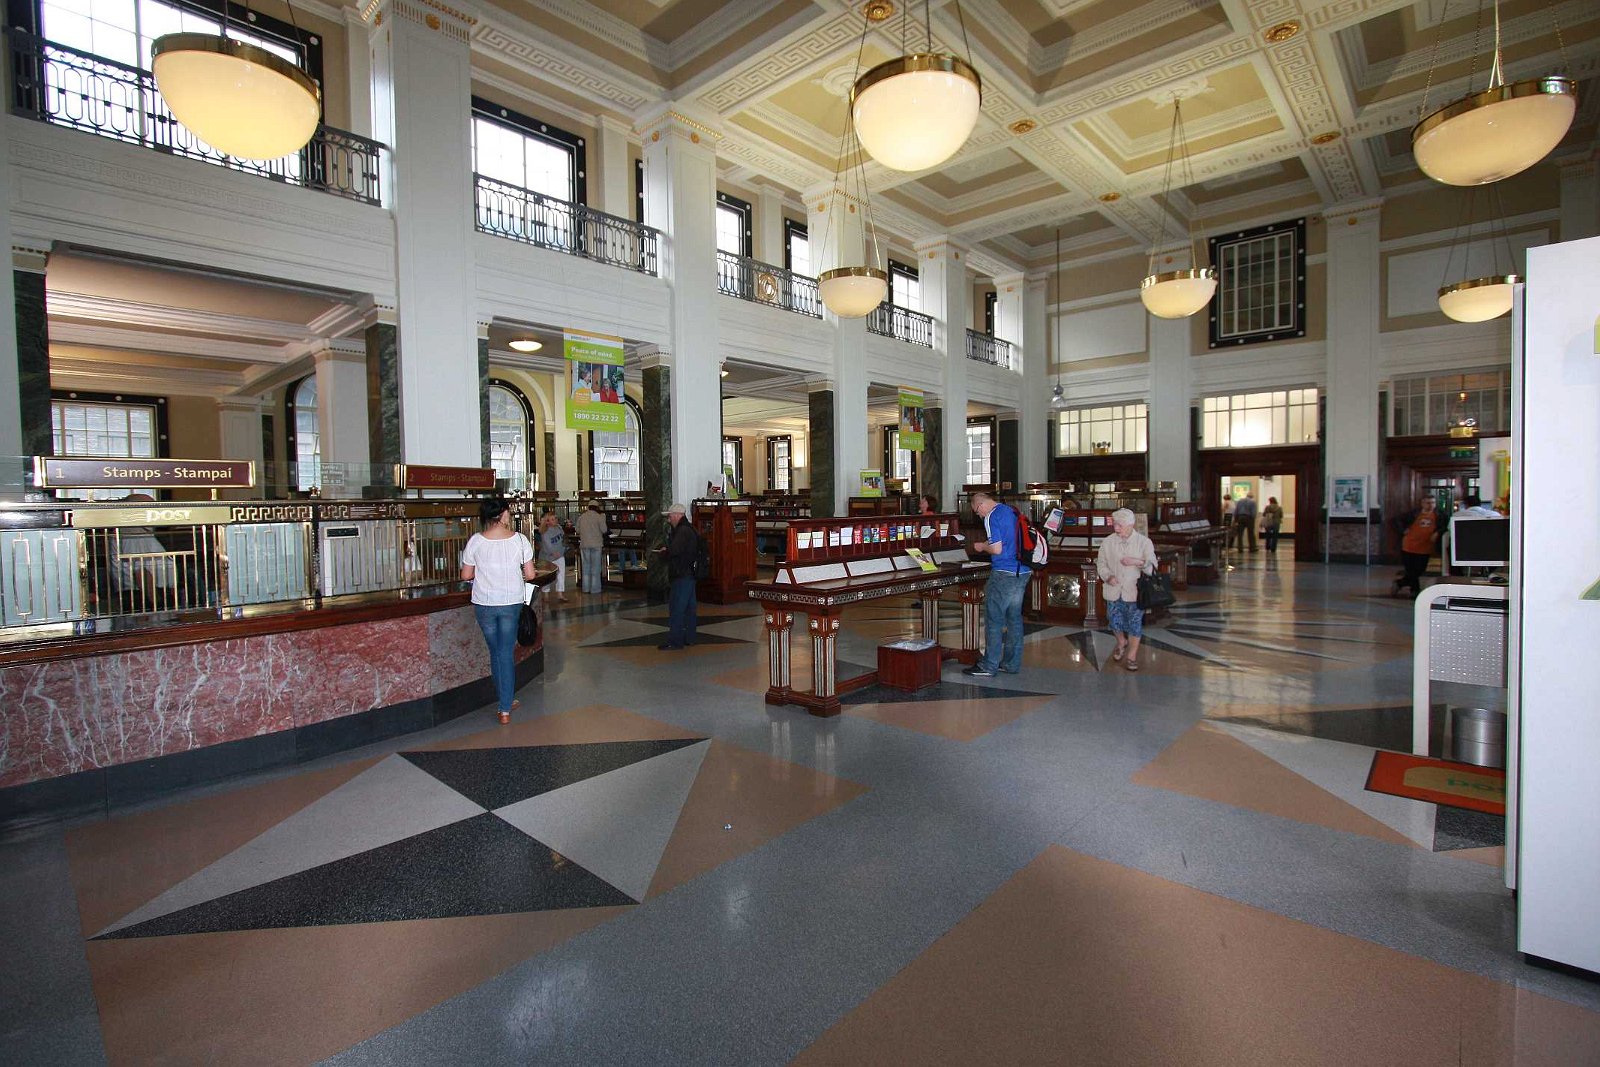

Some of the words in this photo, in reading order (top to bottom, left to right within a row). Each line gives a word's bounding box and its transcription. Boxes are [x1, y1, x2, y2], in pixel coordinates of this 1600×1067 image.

[55, 467, 65, 479] 1
[102, 466, 161, 481] Stamps
[174, 467, 232, 482] Stampaí
[430, 472, 456, 484] Stamps
